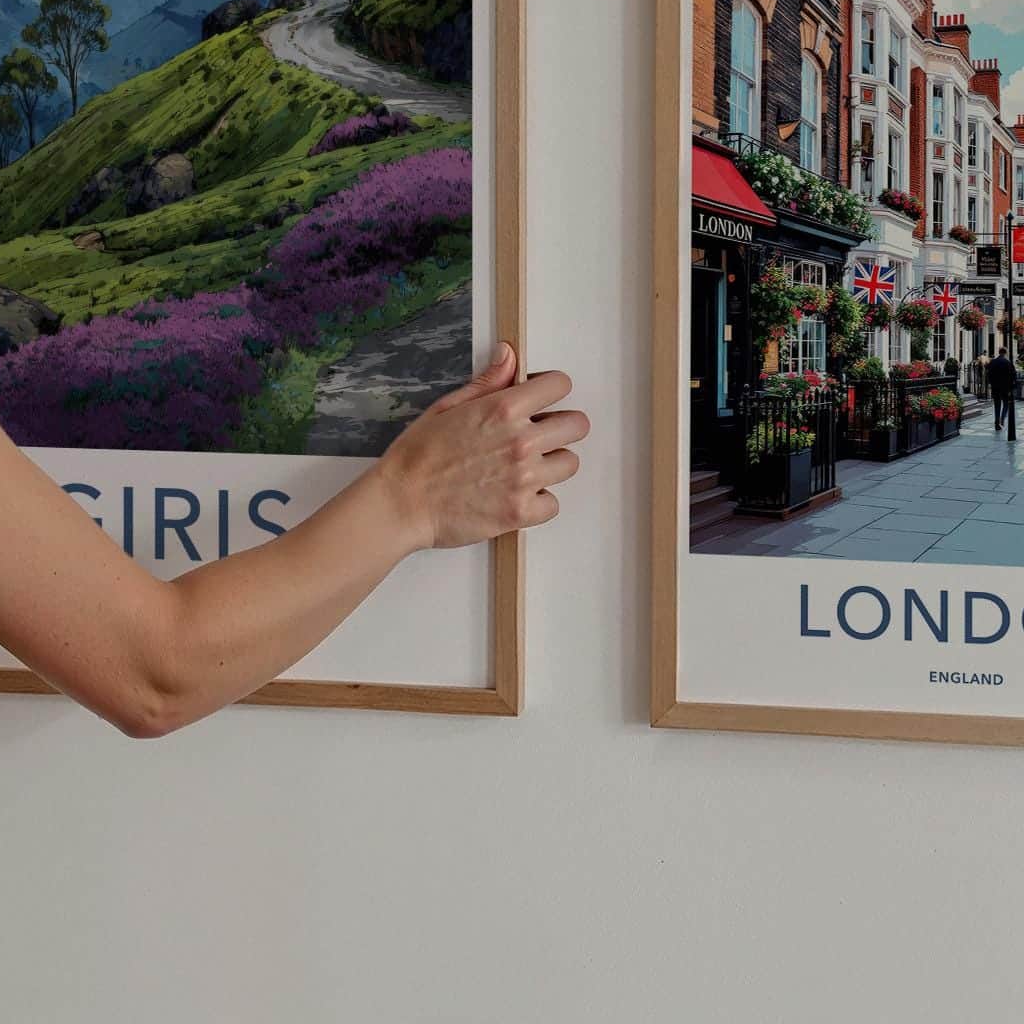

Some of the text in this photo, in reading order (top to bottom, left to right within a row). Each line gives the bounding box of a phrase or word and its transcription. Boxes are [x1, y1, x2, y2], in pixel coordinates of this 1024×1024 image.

[699, 213, 753, 242] LONDON
[800, 583, 1024, 645] LOND
[929, 670, 1004, 686] ENGLAND
